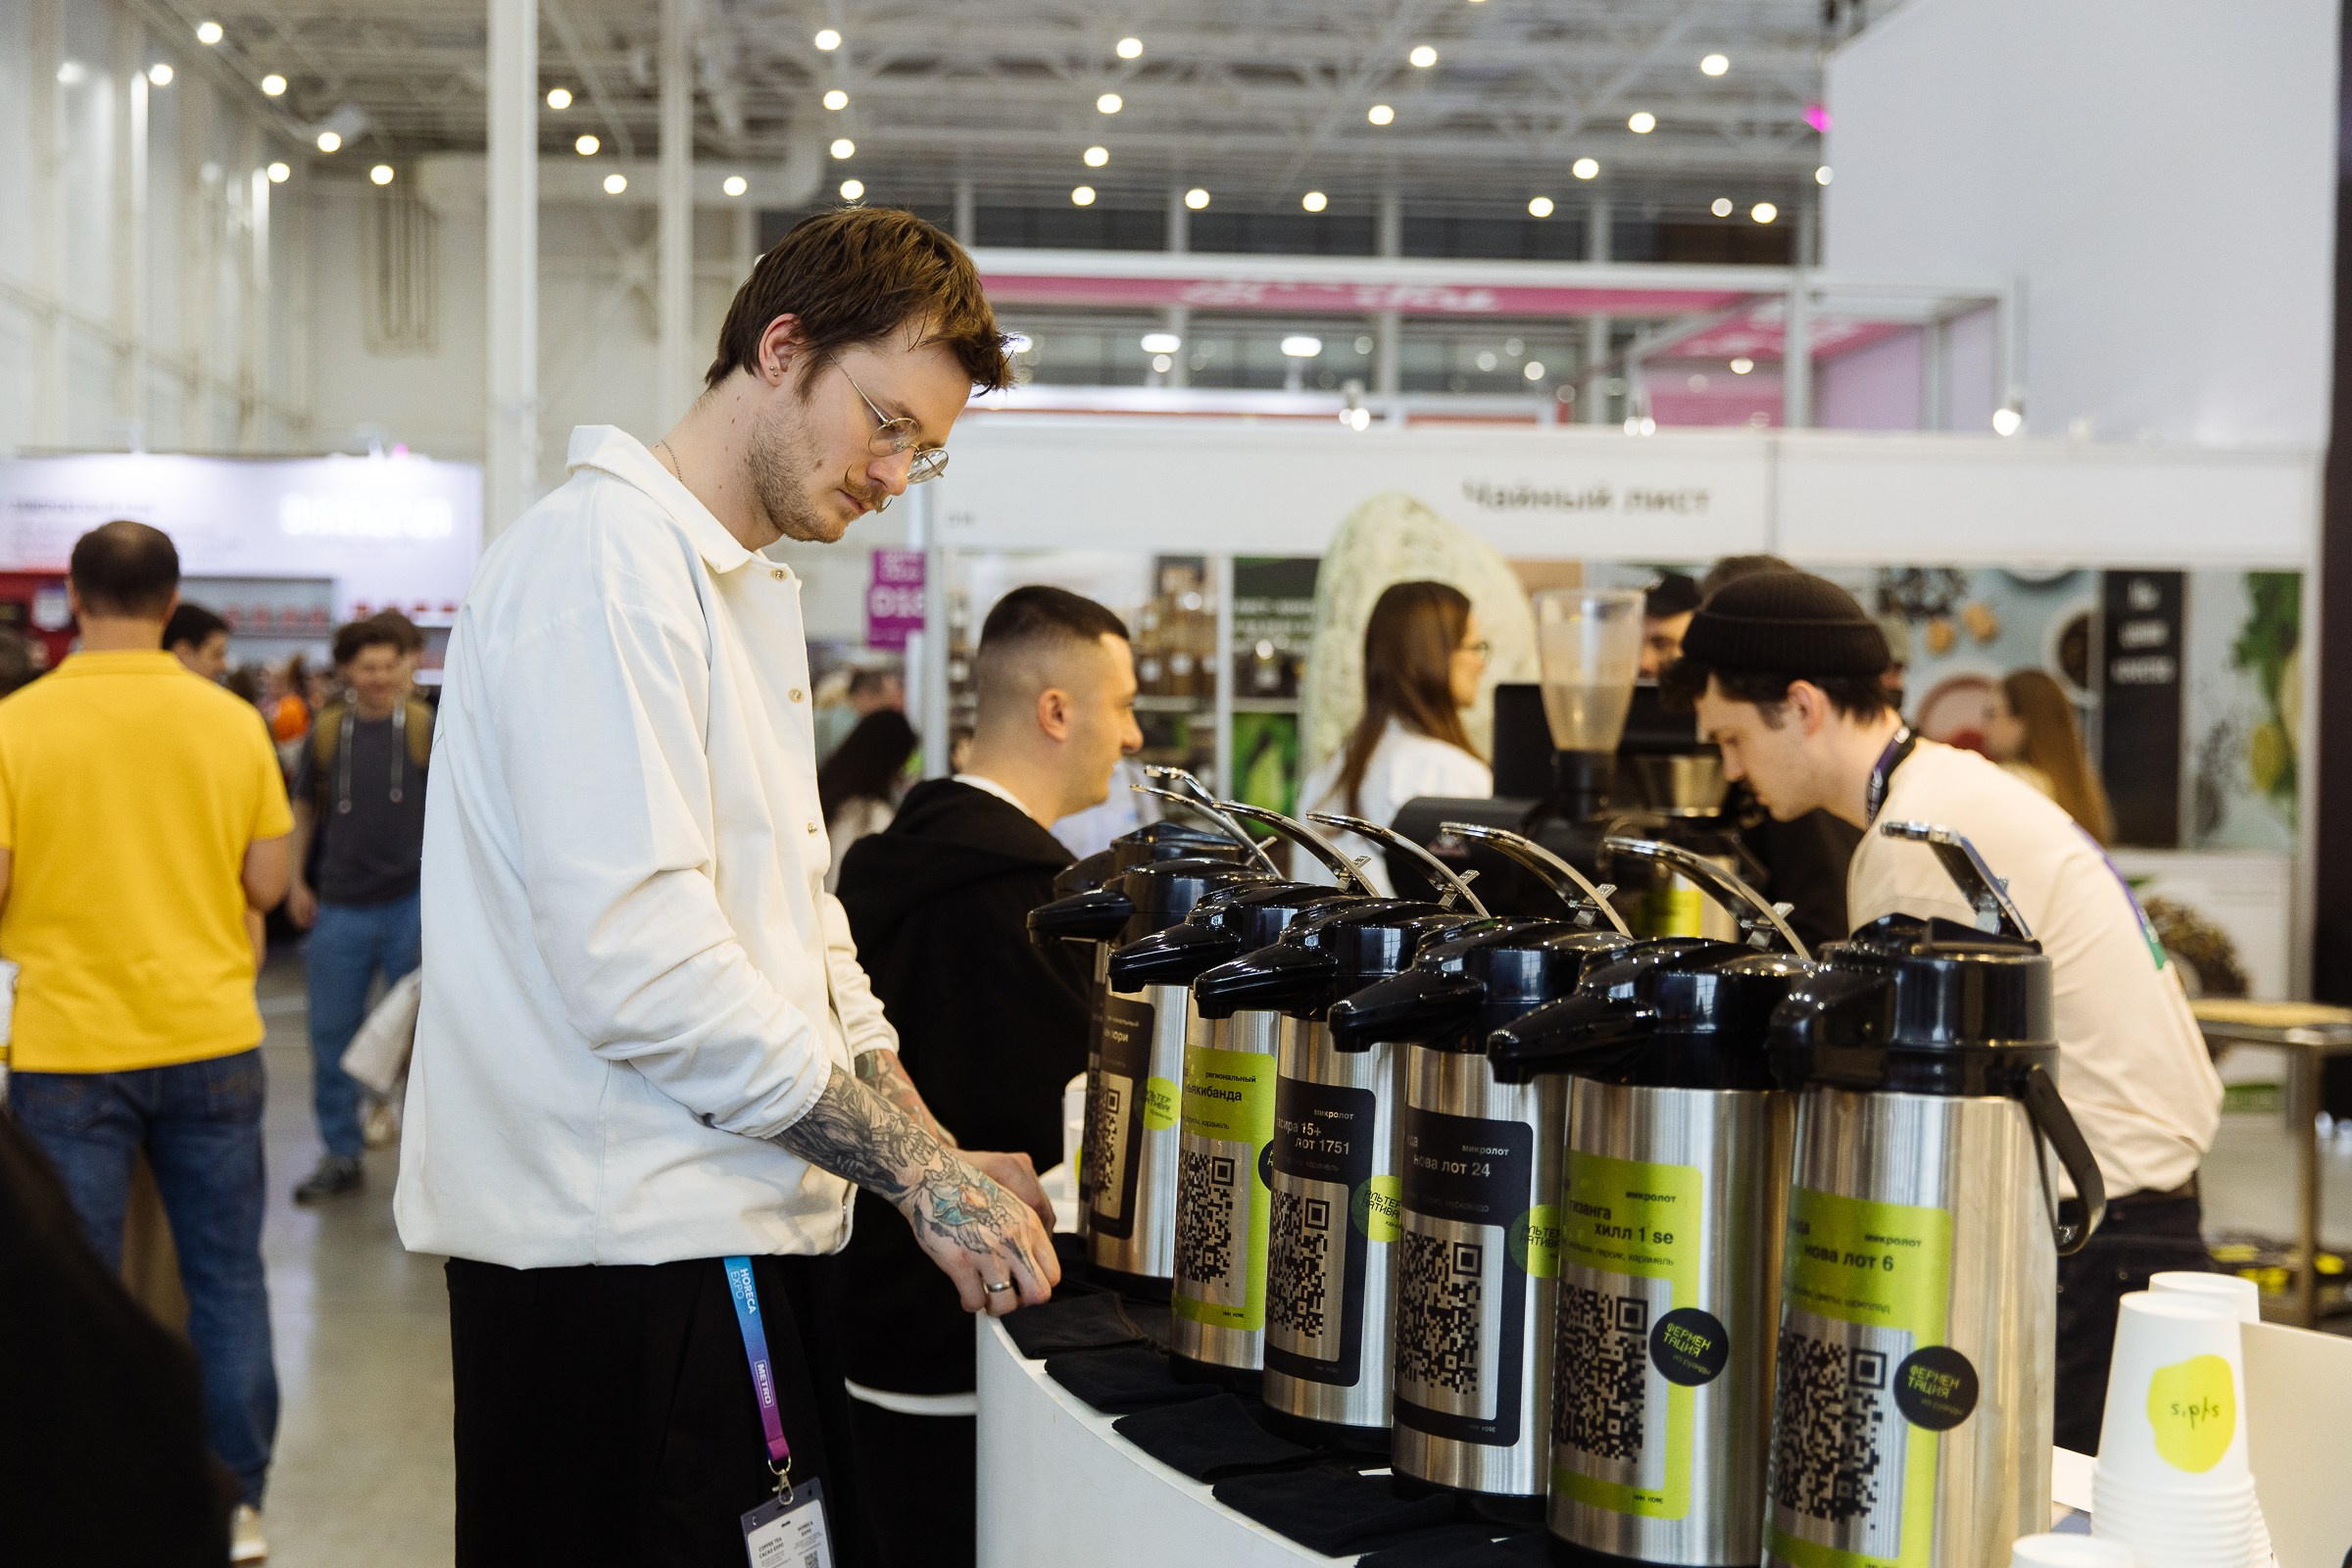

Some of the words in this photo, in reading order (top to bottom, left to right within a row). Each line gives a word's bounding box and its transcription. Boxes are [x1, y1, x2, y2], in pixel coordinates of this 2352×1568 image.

[1462, 475, 1613, 514] Чайный
[1205, 1070, 1256, 1083] региональный
[1314, 1108, 1354, 1120] микролот
[1300, 1122, 1322, 1137] 15+
[1295, 1137, 1316, 1151] лот
[1319, 1139, 1350, 1155] 1751
[1461, 1144, 1510, 1156] микролот
[1441, 1160, 1468, 1176] лот
[1471, 1162, 1492, 1178] 24
[1625, 1191, 1677, 1203] микролот
[1593, 1222, 1633, 1241] хилл
[1638, 1226, 1645, 1244] 1
[1651, 1230, 1674, 1246] se
[1864, 1233, 1922, 1249] микролот
[1804, 1244, 1838, 1264] нова
[1842, 1250, 1878, 1269] лот
[1882, 1254, 1894, 1273] 6
[730, 1270, 745, 1300] EXPO
[740, 1267, 757, 1315] HORECA
[1663, 1331, 1701, 1358] ТАЦИЯ
[1666, 1322, 1712, 1351] ФЕРМЕН
[757, 1362, 772, 1405] METRO
[1910, 1363, 1961, 1391] ФЕРМЕН
